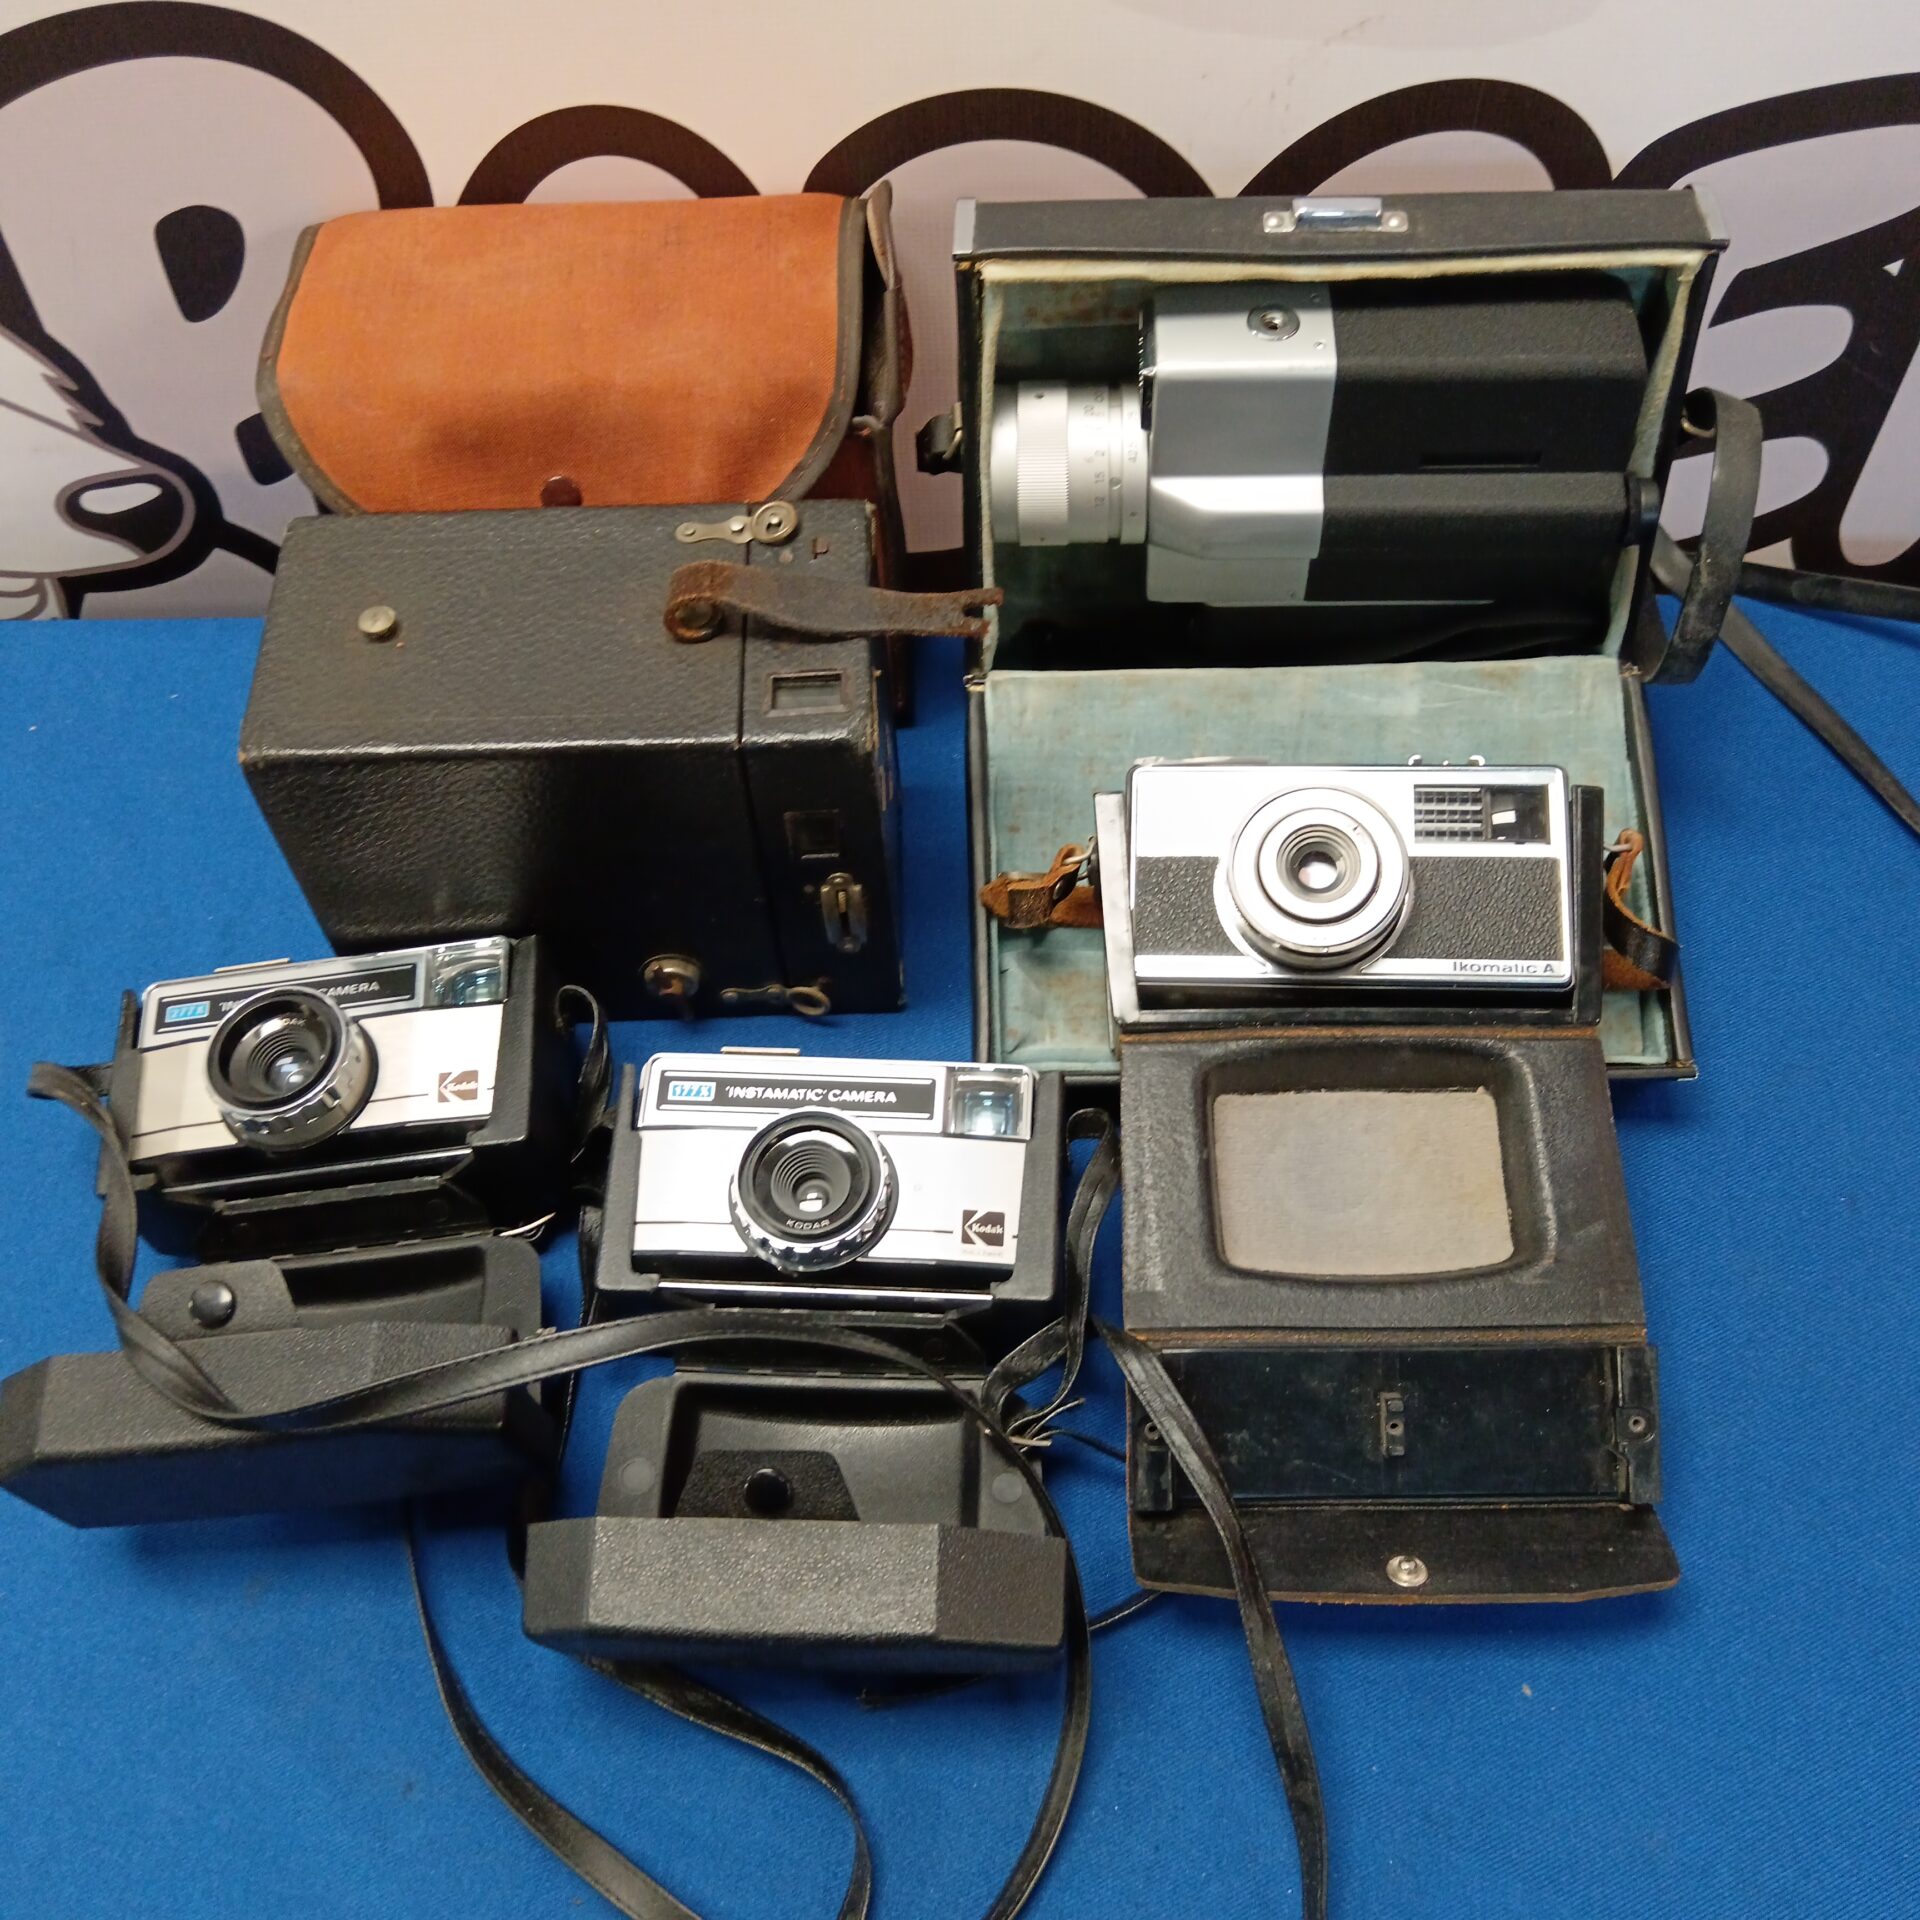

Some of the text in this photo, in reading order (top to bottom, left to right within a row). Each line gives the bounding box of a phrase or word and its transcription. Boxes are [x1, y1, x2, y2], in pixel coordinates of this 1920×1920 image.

[1452, 961, 1556, 974] Ikomatic A
[317, 981, 381, 1000] CAMERA
[828, 1089, 898, 1104] CAMERA
[970, 1221, 1004, 1235] Kodak
